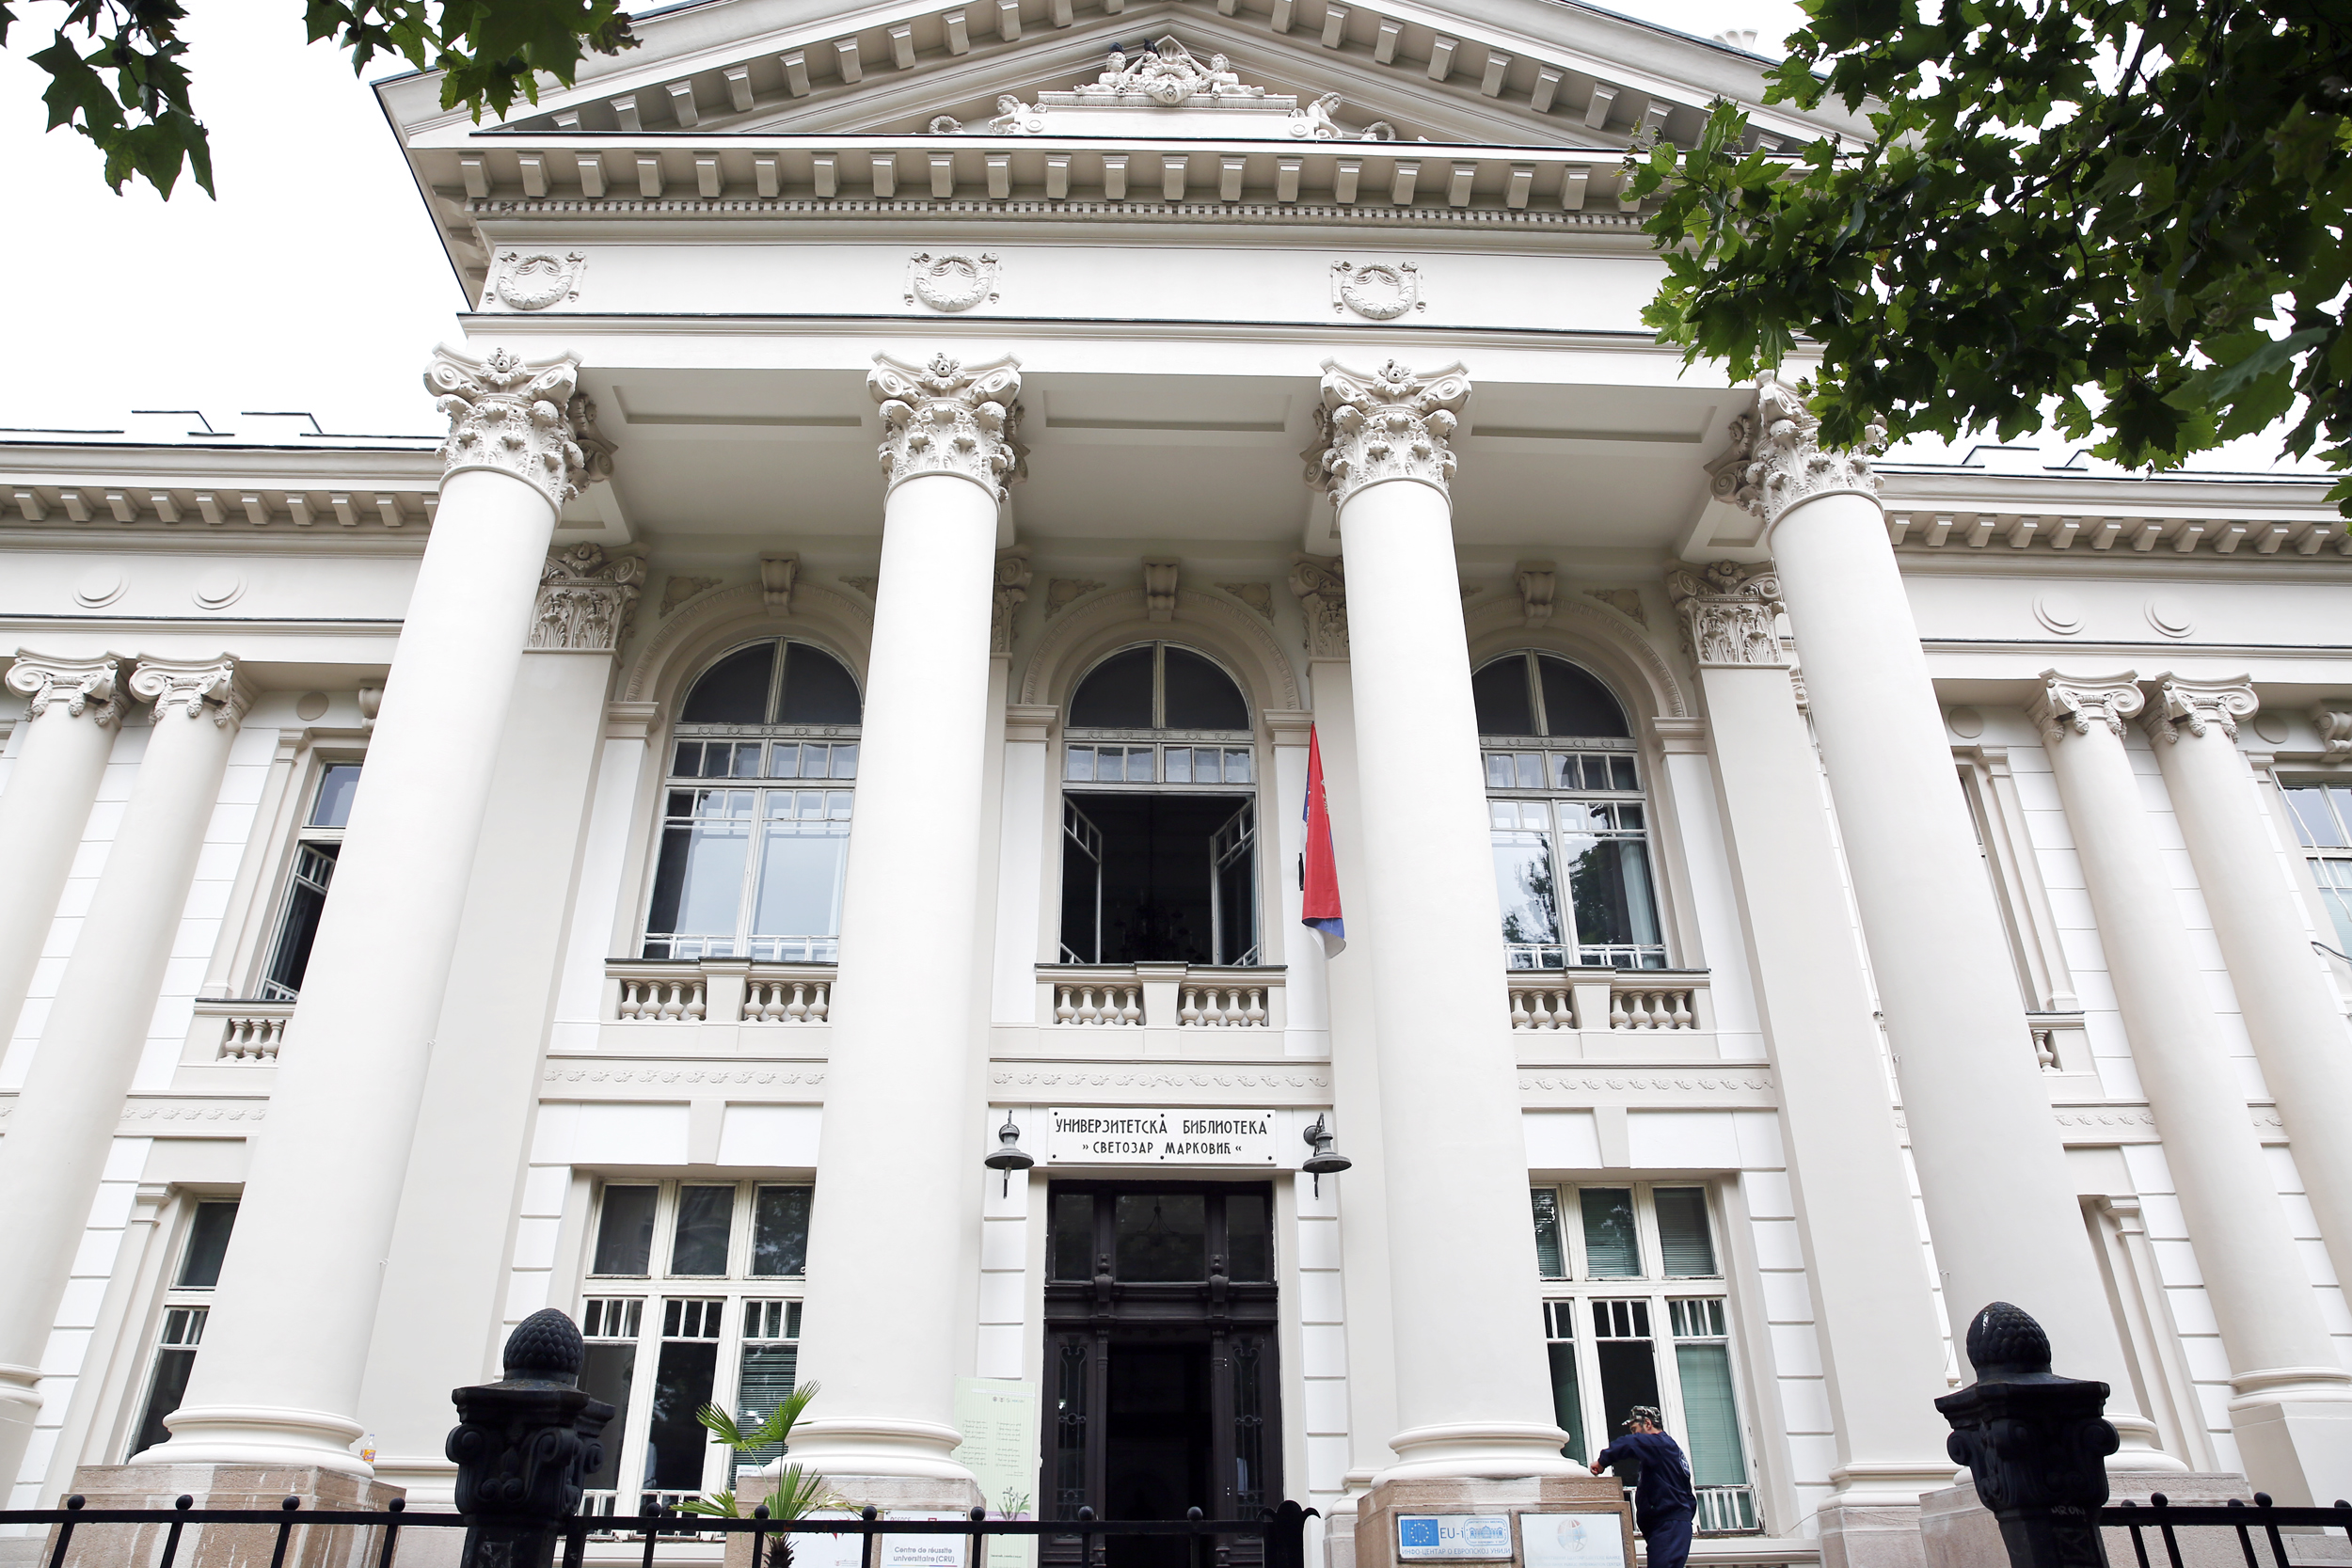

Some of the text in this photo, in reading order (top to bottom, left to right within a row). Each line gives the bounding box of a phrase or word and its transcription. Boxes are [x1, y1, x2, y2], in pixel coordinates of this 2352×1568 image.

[1056, 1118, 1267, 1134] УНИВЕРЗИТЕТСКА БИБЛИОТЕКА
[1439, 1527, 1464, 1539] EU-i
[1402, 1547, 1446, 1556] ИНФО-ЦЕНТАР
[935, 1555, 955, 1563] (CRU)
